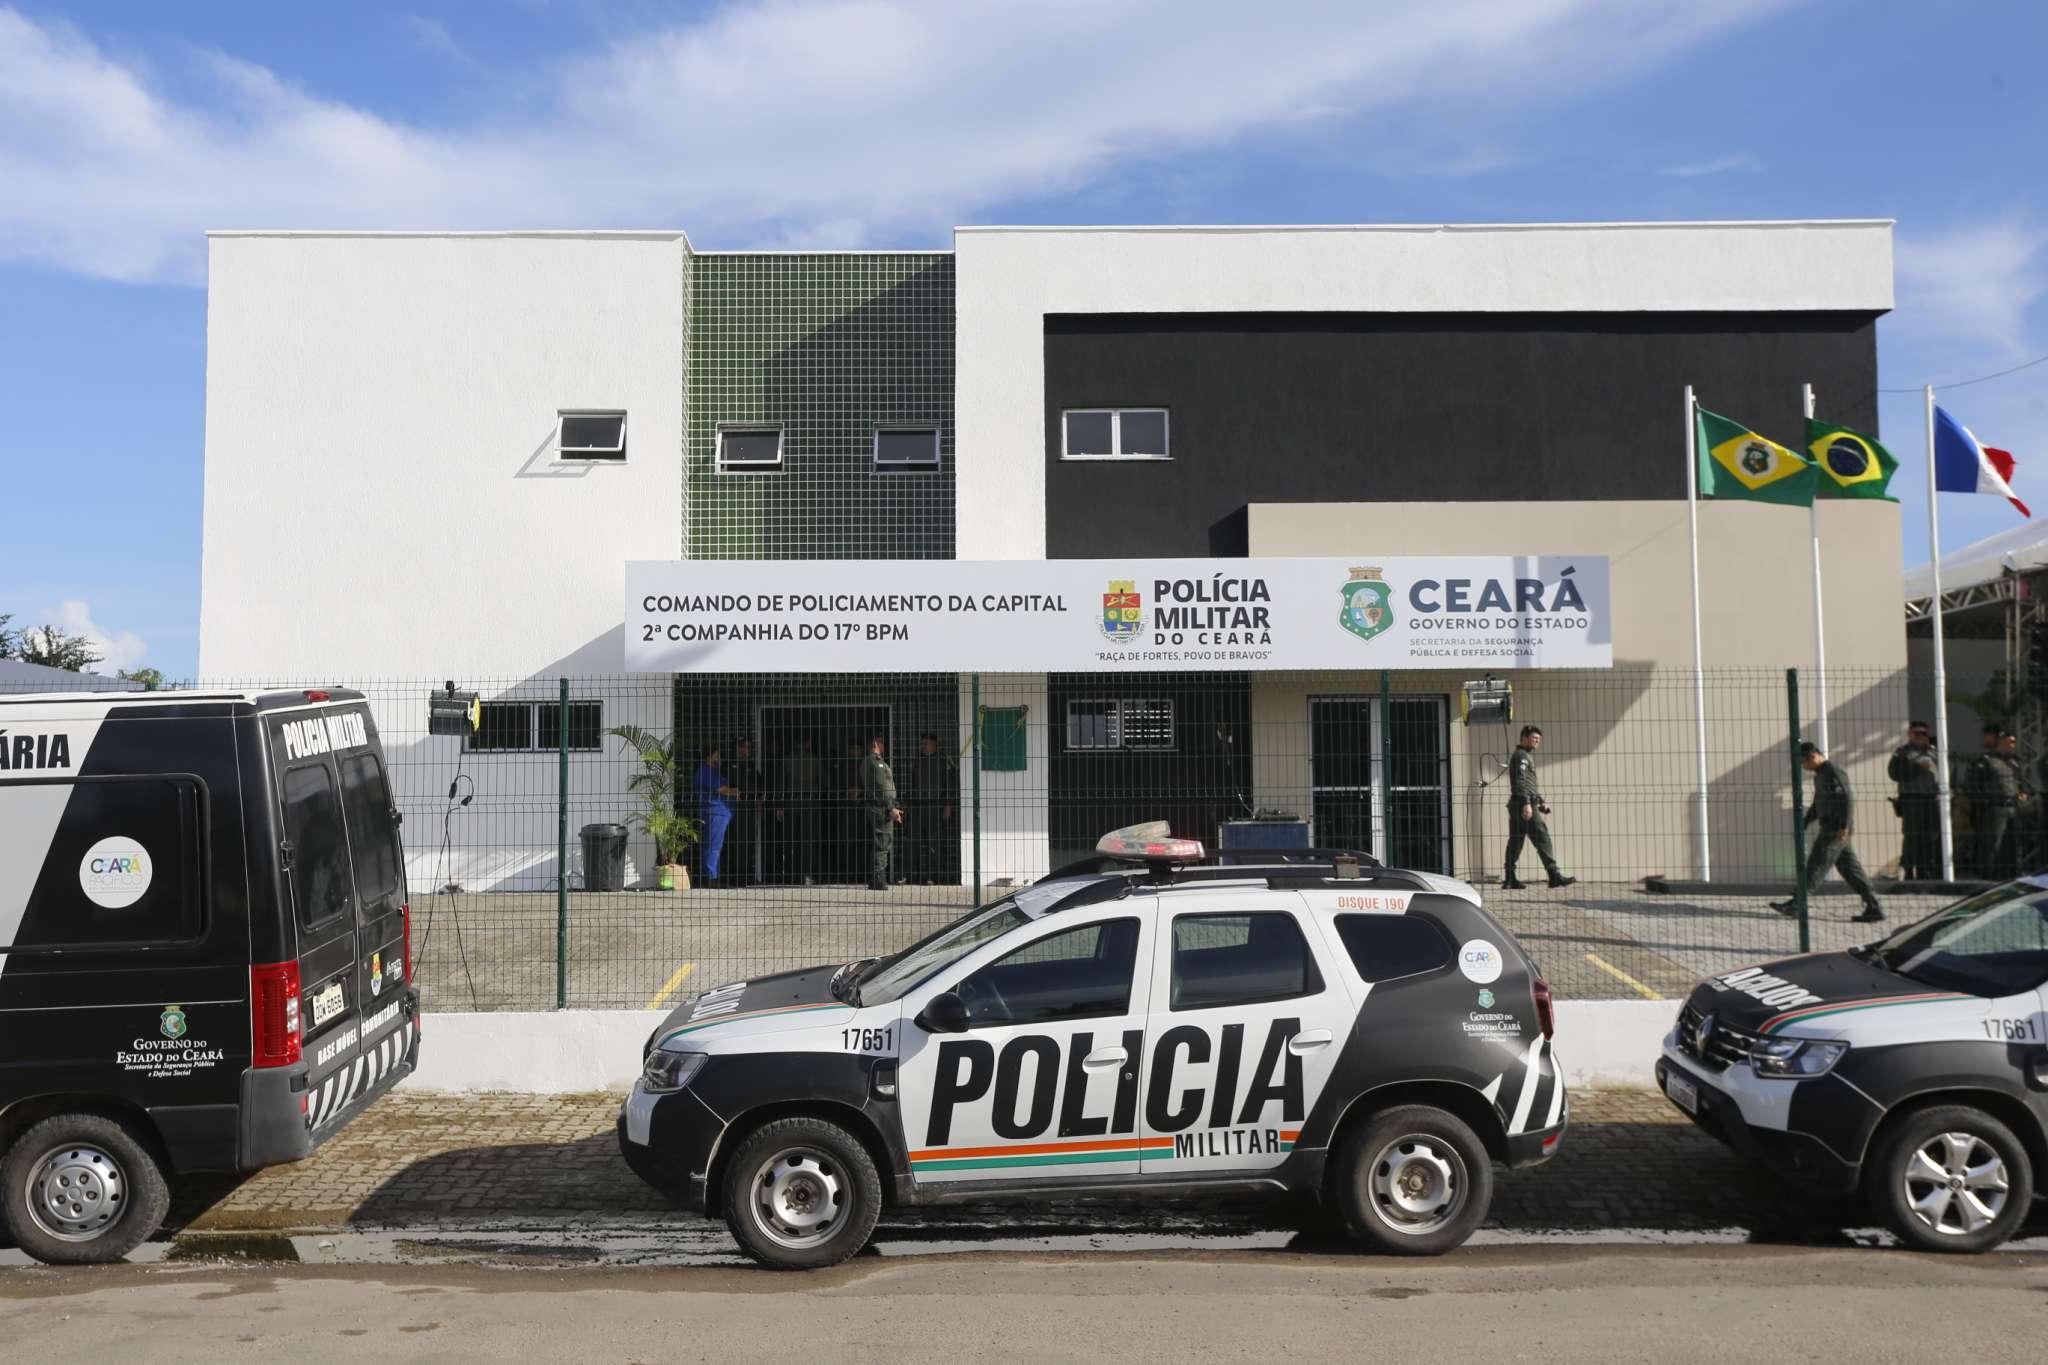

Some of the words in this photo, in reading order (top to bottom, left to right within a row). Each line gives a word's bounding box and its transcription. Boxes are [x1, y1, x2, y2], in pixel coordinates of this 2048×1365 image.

[1154, 572, 1271, 602] POLÍCIA
[1408, 565, 1587, 614] CEARÁ
[642, 595, 752, 613] COMANDO
[757, 595, 784, 613] DE
[788, 594, 943, 613] POLICIAMENTO
[949, 595, 978, 612] DA
[982, 594, 1068, 612] CAPITAL
[1154, 606, 1271, 629] MILITAR
[1409, 618, 1493, 630] GOVERNO
[1496, 618, 1520, 629] DO
[1524, 617, 1588, 629] ESTADO
[667, 623, 793, 642] COMPANHIA
[799, 624, 830, 642] DO
[866, 624, 909, 641] BPM
[1154, 633, 1184, 645] DO
[1198, 628, 1272, 645] CEARÁ
[1410, 638, 1466, 646] SECRETARIA
[1485, 638, 1544, 647] SEGURANÇA
[1128, 652, 1140, 661] DE
[1142, 652, 1181, 662] FORTES,
[1184, 652, 1212, 661] POVO
[1214, 652, 1227, 661] DE
[1410, 648, 1451, 657] PÚBLICA
[326, 712, 368, 751] MILITAR
[1338, 896, 1379, 910] DISQUE
[1384, 897, 1404, 910] 190
[1980, 1018, 2036, 1040] 17661
[133, 1038, 191, 1050] GOVERNO
[317, 1041, 335, 1066] BASE
[336, 1027, 357, 1054] MÓVEL
[842, 1028, 892, 1051] 17651
[116, 1051, 163, 1064] ESTADO
[183, 1049, 224, 1061] CEARÁ
[925, 1017, 1305, 1147] POLICIA
[1175, 1129, 1279, 1158] MILITAR
